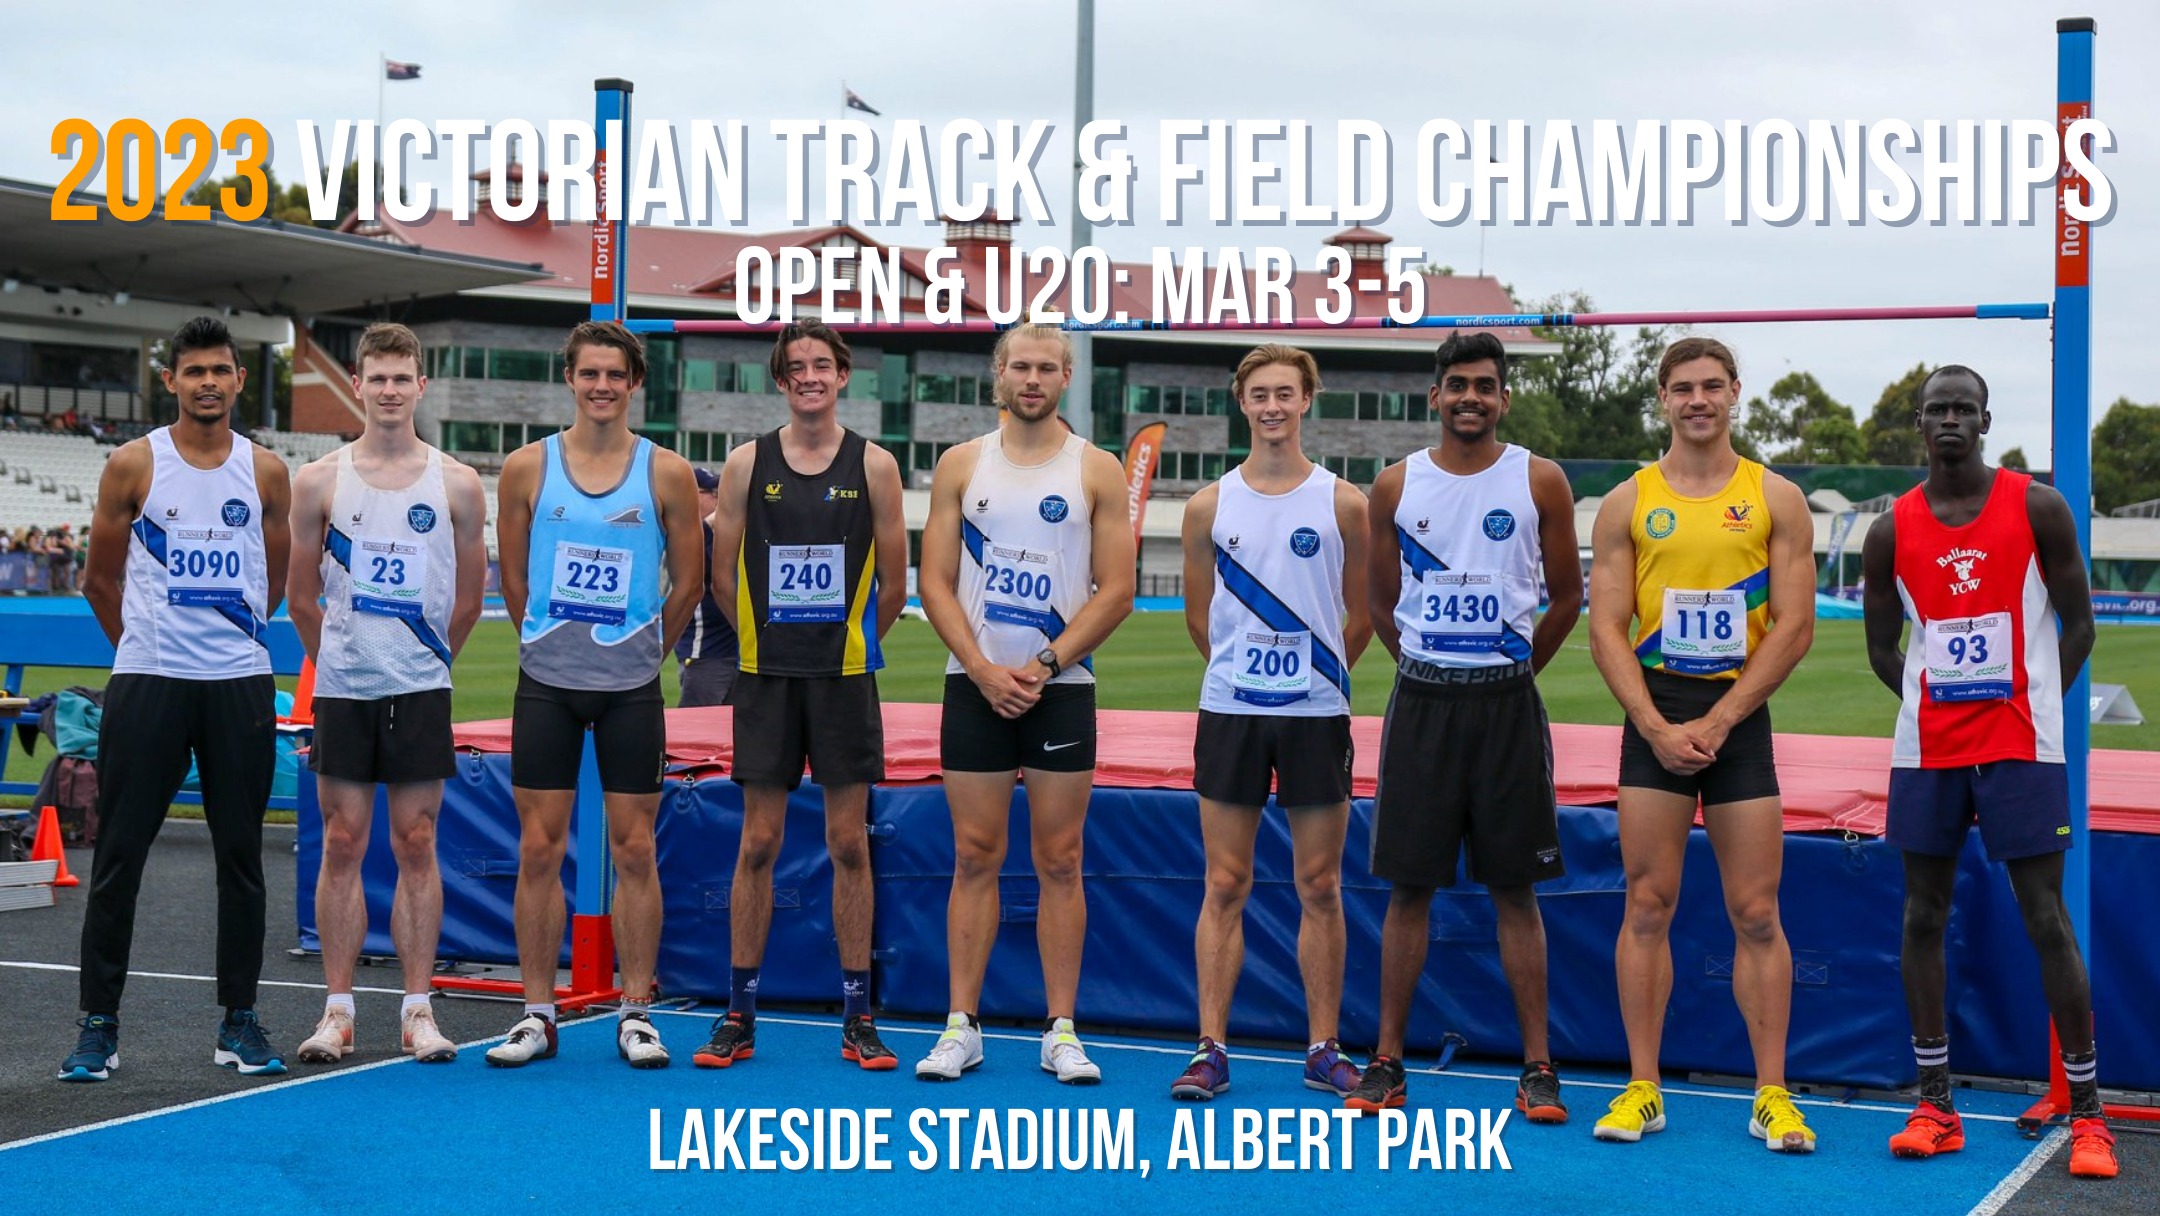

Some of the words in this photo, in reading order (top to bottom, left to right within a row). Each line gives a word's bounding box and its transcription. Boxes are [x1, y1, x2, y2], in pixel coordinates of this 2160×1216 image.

[1456, 316, 1540, 328] nordicsport.com
[169, 549, 240, 578] 3090
[371, 556, 405, 585] 23
[1936, 547, 1988, 569] Ballaarat
[566, 561, 619, 592] 223
[780, 563, 832, 590] 240
[985, 564, 1051, 601] 2300
[1949, 578, 1981, 596] YCW
[1424, 594, 1500, 623] 3430
[1677, 609, 1733, 640] 118
[1246, 647, 1300, 677] 200
[1947, 634, 1989, 666] 93
